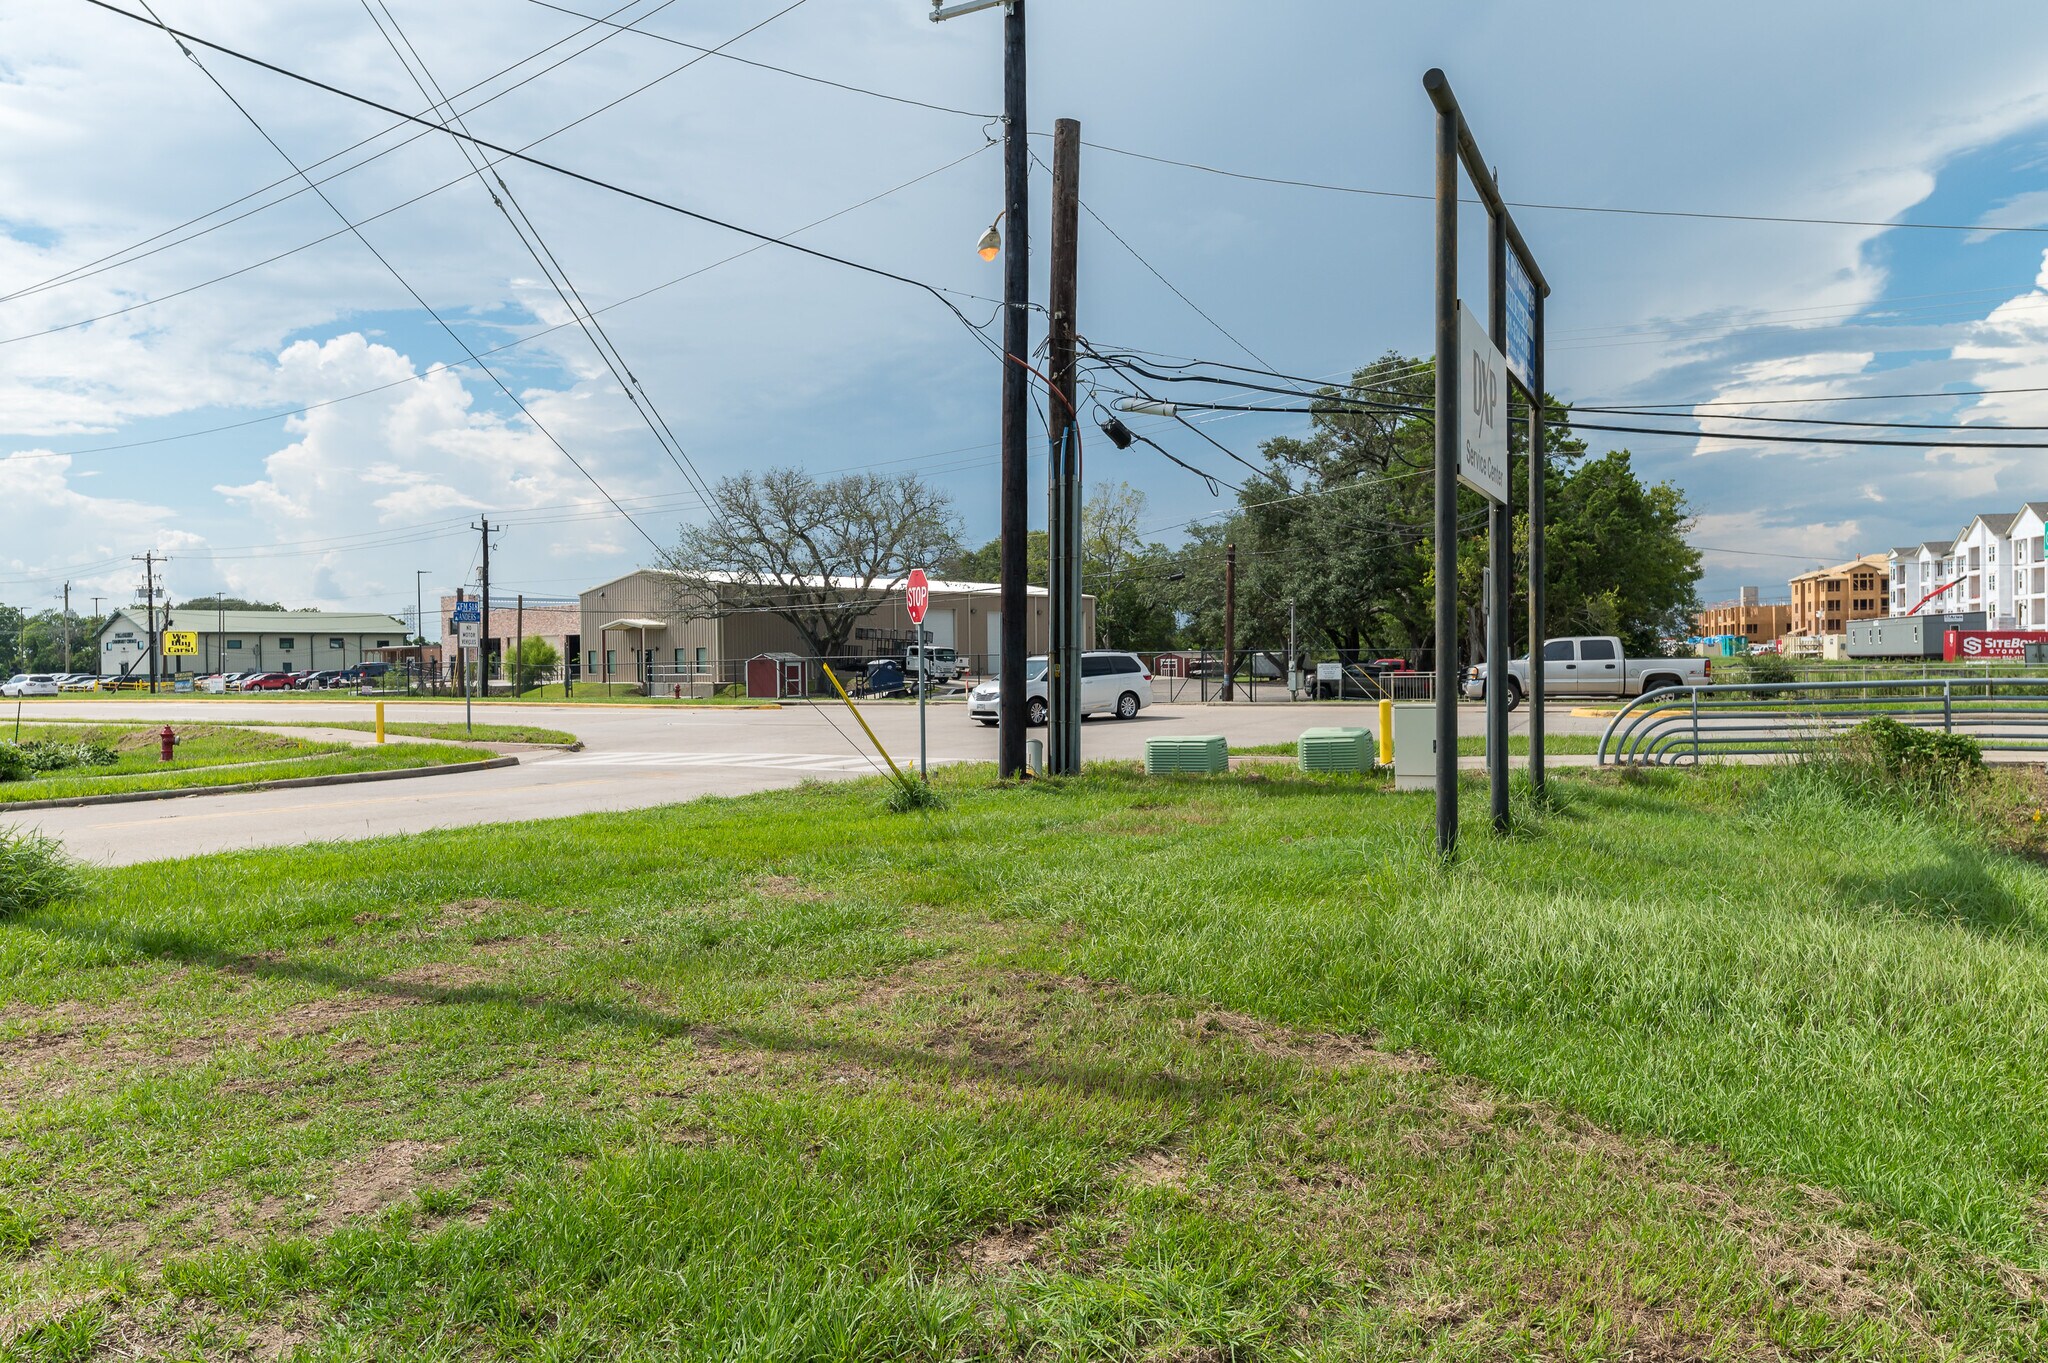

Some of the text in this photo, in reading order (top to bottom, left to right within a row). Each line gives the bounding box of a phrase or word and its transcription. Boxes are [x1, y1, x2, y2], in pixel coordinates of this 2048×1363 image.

[1473, 348, 1497, 438] DXP
[1466, 439, 1504, 488] Service Center
[908, 586, 927, 607] STOP
[459, 612, 477, 621] ANDERS
